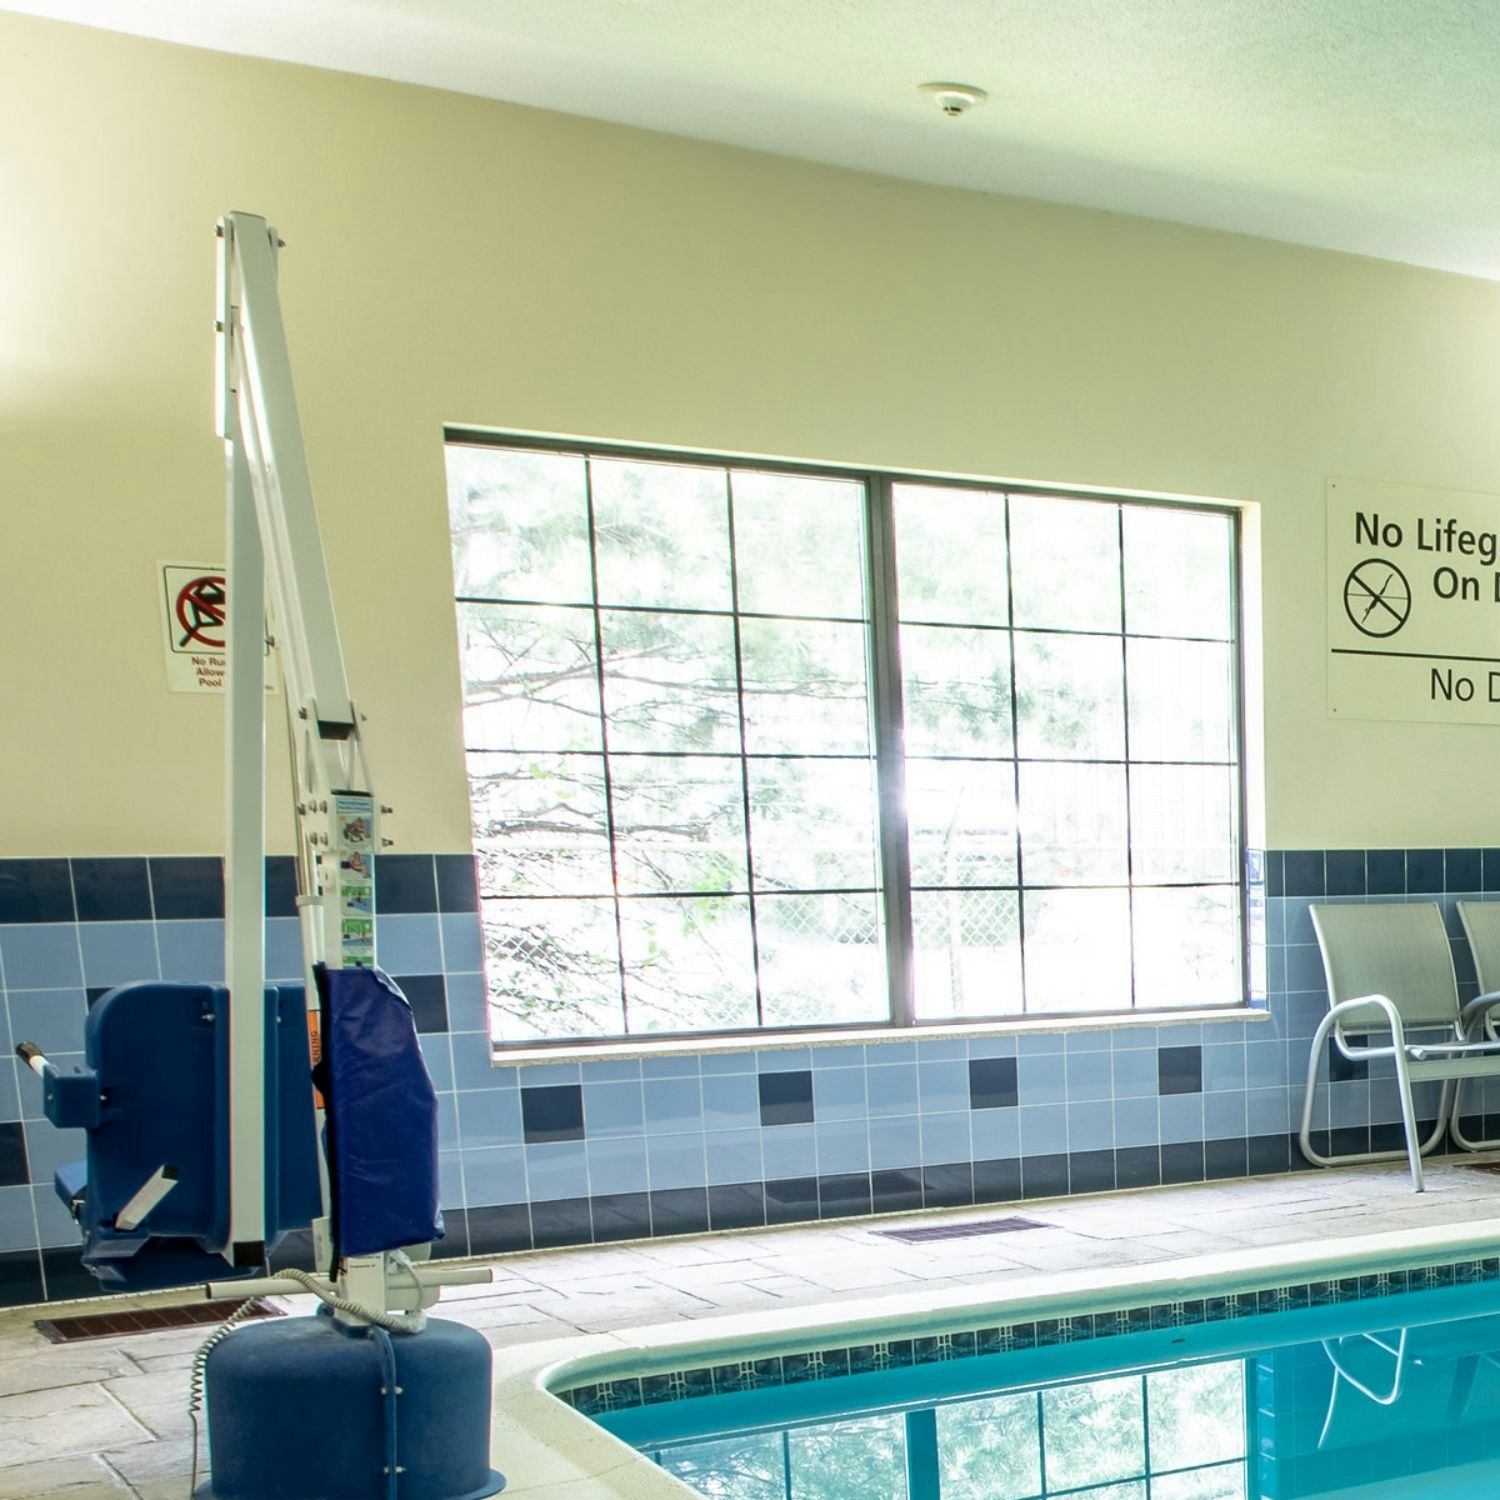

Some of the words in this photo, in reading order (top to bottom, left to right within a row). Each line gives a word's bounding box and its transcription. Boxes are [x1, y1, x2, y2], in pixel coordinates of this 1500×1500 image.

[1355, 511, 1403, 548] No
[1433, 566, 1481, 602] On
[192, 657, 206, 665] No
[196, 667, 225, 676] Allow
[198, 678, 222, 687] Pool
[1429, 668, 1474, 702] No
